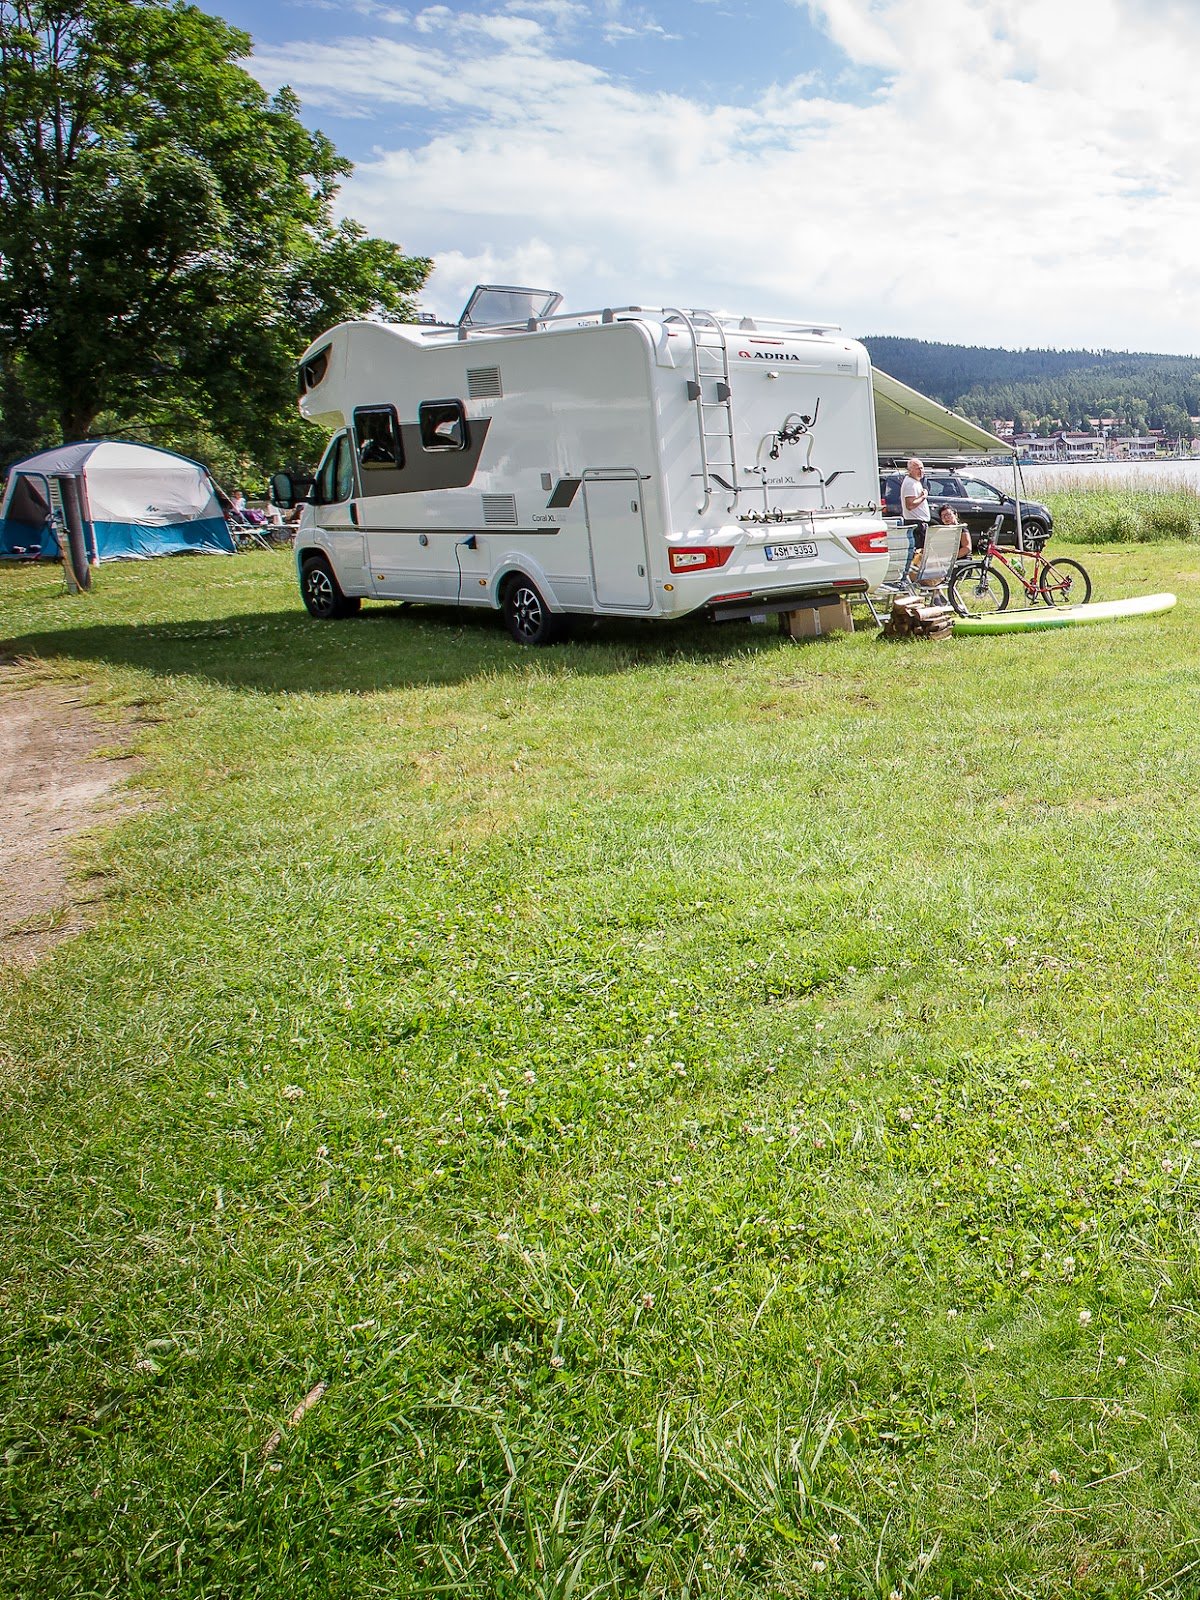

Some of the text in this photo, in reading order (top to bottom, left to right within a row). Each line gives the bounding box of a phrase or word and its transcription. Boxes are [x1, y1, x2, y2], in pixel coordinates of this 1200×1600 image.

[754, 351, 800, 361] ADRIA
[766, 476, 796, 484] oral XL
[793, 544, 814, 555] 9353
